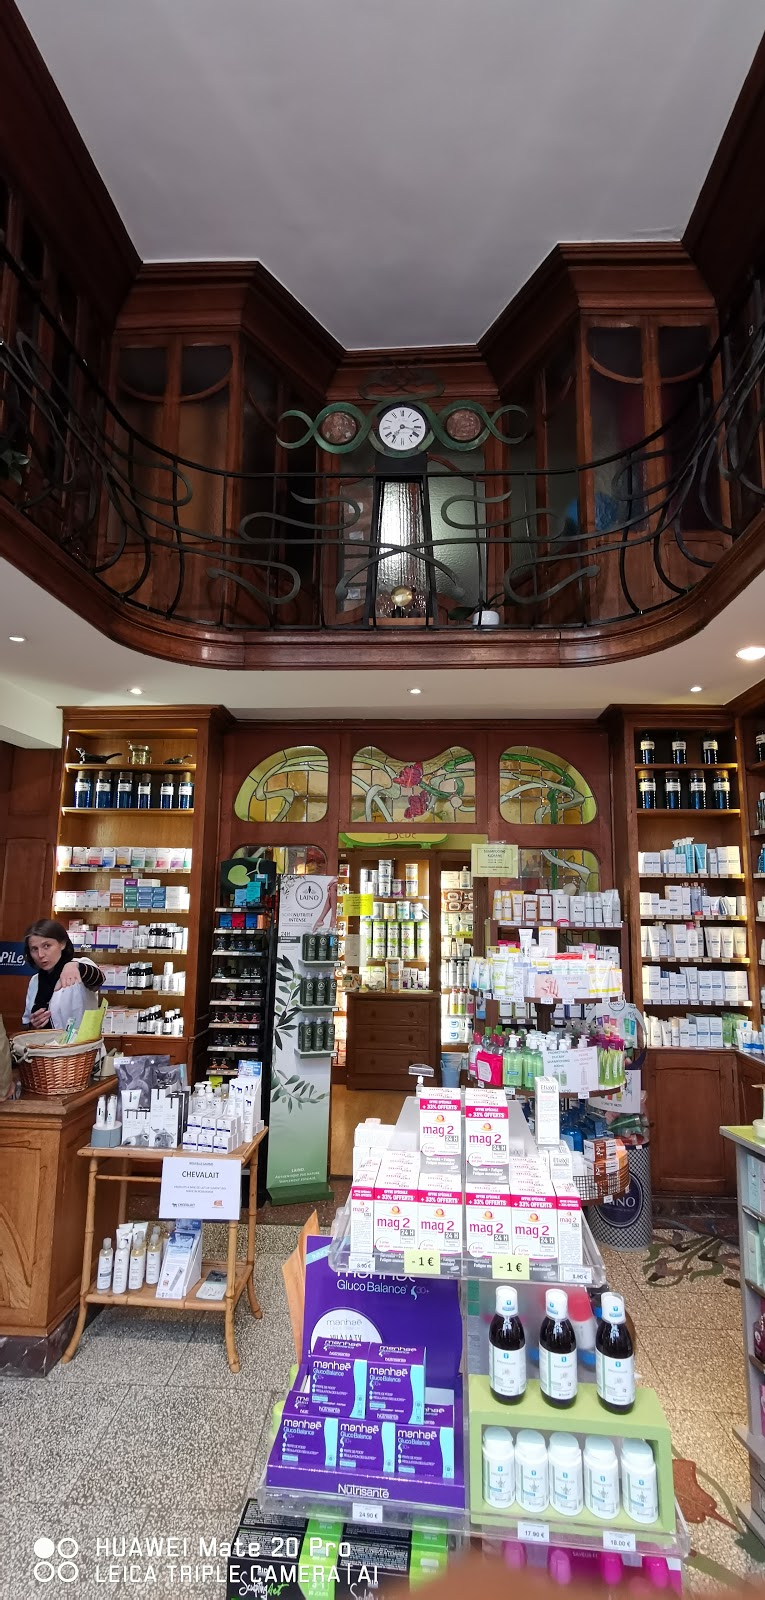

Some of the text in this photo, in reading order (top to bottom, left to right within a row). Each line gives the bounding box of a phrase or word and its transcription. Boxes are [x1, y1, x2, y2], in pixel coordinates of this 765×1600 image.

[423, 1125, 455, 1138] mag 2
[469, 1133, 502, 1147] mag 2
[181, 1170, 220, 1179] CHEVALAIT
[609, 1196, 636, 1208] INO
[377, 1217, 411, 1231] mag 2
[421, 1220, 455, 1234] mag 2
[469, 1223, 504, 1236] mag 2
[515, 1225, 550, 1239] mag 2
[418, 1256, 426, 1267] 1
[427, 1256, 435, 1267] €
[506, 1262, 512, 1272] 1
[515, 1262, 523, 1273] €
[313, 1360, 352, 1372] manhaë
[369, 1366, 408, 1378] manhaë
[283, 1418, 322, 1432] manhaë
[340, 1422, 380, 1435] manhaë
[397, 1429, 438, 1442] manhaë
[337, 1483, 390, 1500] Nutrisanté
